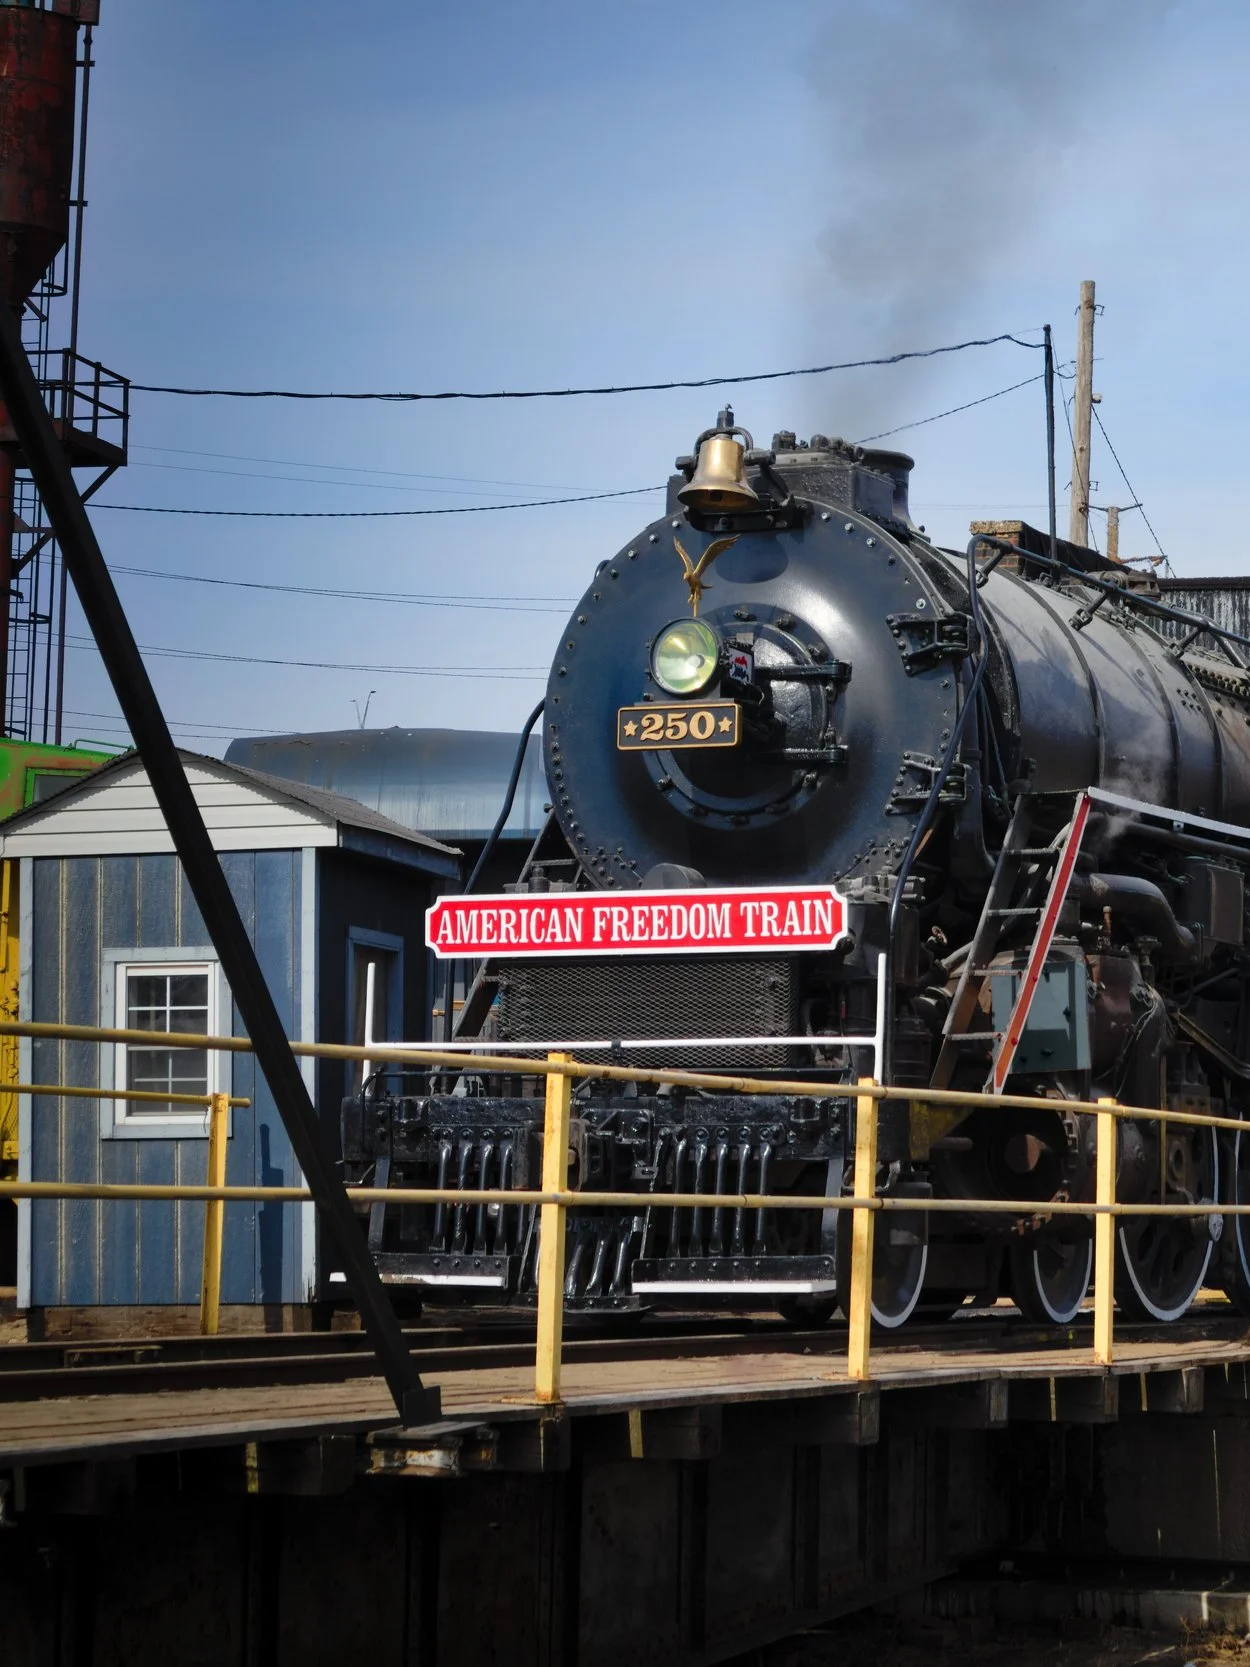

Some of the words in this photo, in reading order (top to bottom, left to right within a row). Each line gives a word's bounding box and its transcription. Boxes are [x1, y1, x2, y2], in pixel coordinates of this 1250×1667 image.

[640, 711, 716, 741] 250
[436, 907, 583, 945] AMERICAN
[592, 903, 732, 942] FREEDOM
[740, 899, 834, 938] TRAIN
